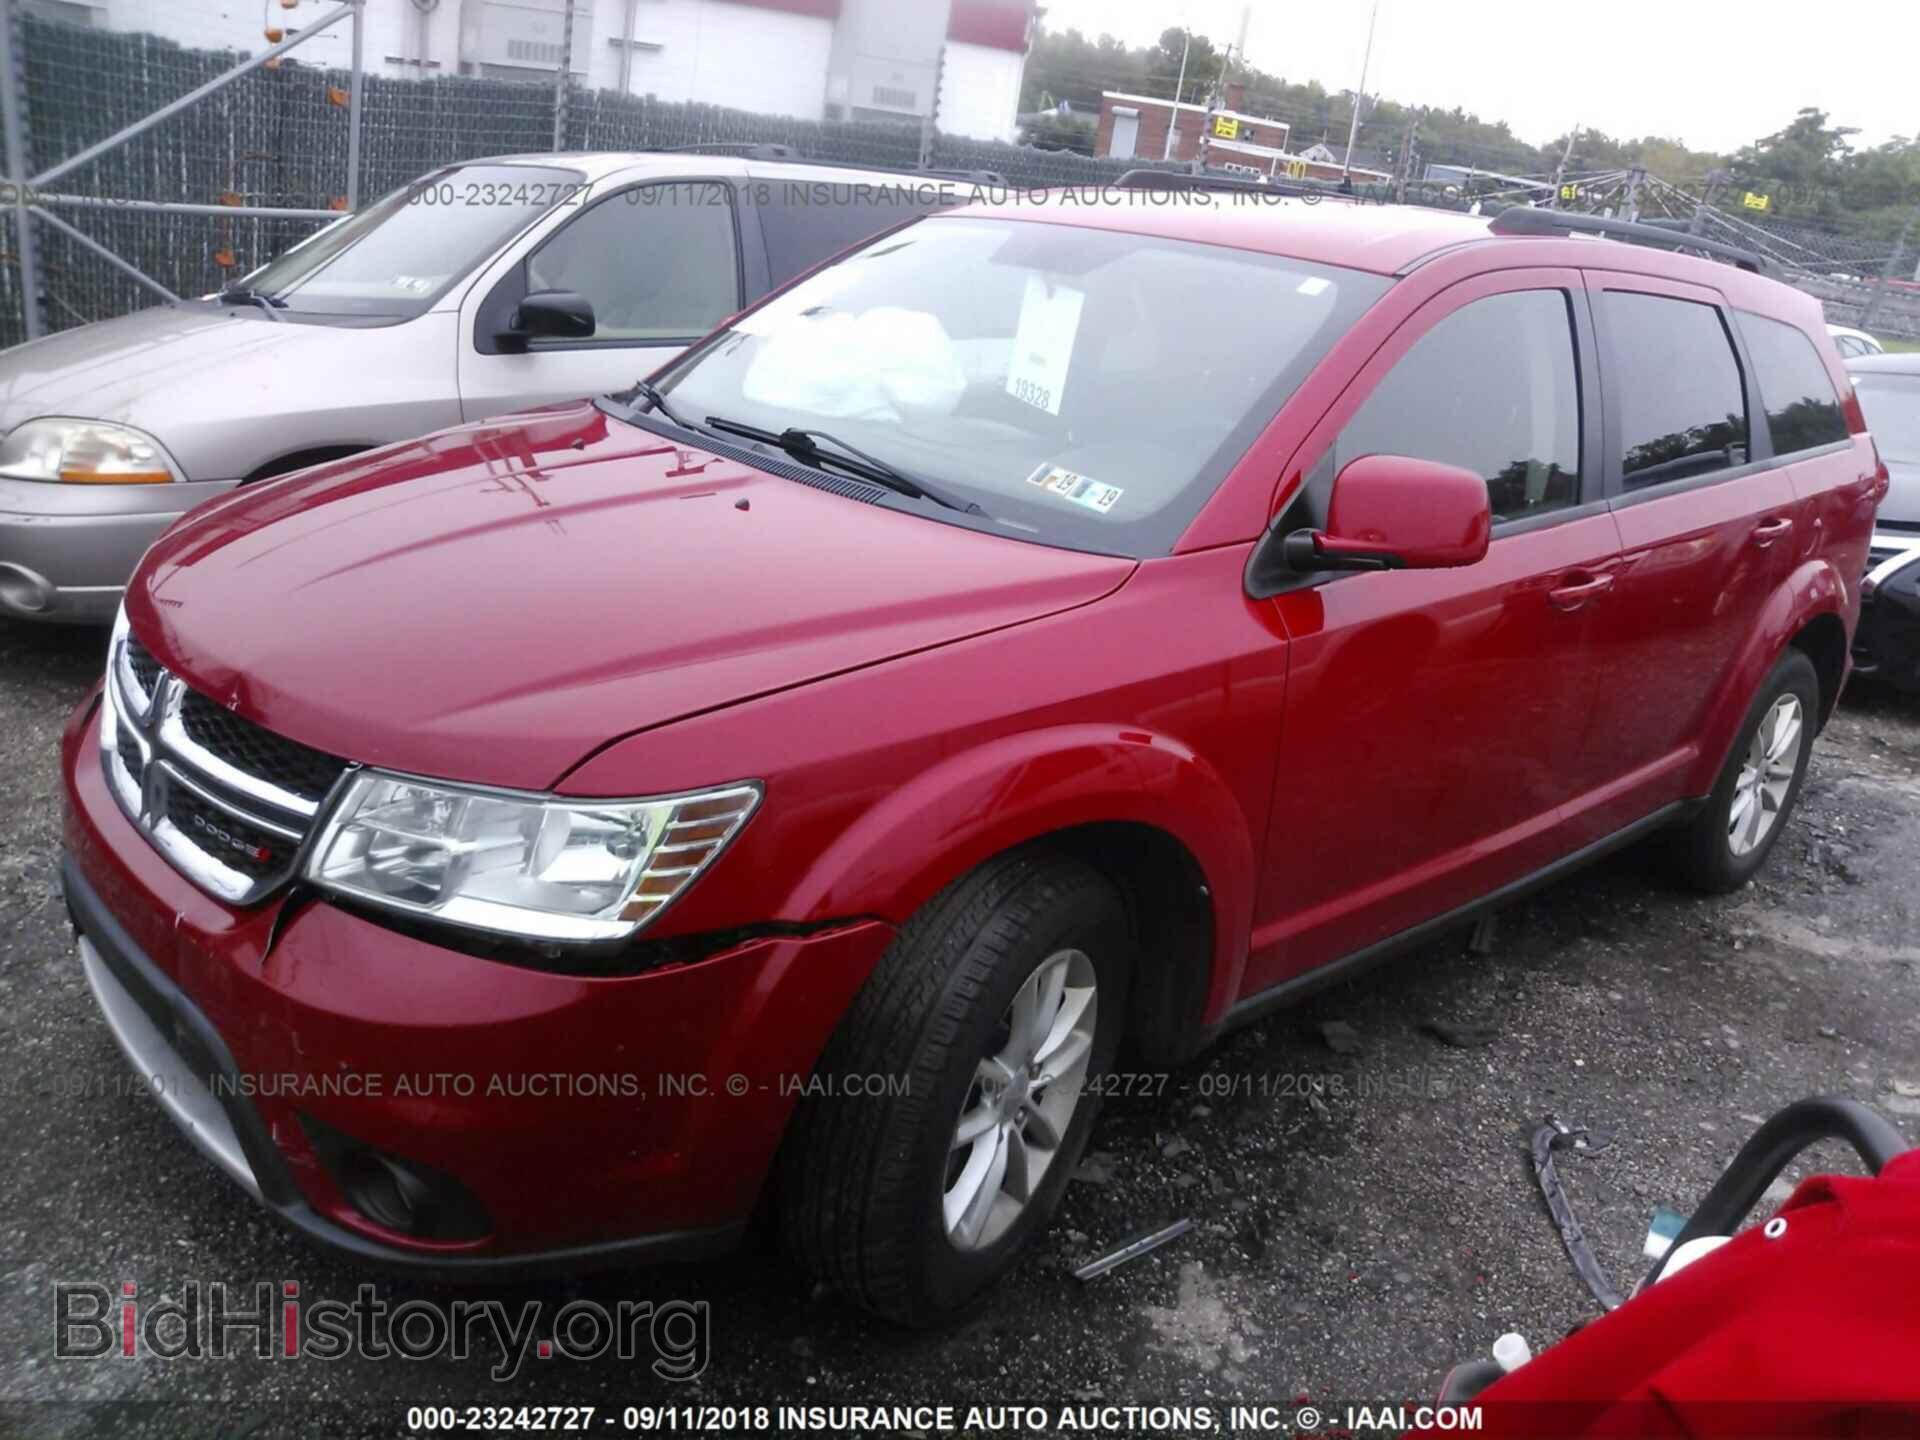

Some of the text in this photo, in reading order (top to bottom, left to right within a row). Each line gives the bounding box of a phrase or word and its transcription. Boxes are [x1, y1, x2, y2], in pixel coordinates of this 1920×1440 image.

[1015, 376, 1050, 409] 19328
[1096, 488, 1119, 507] 19
[194, 813, 260, 858] DODGE
